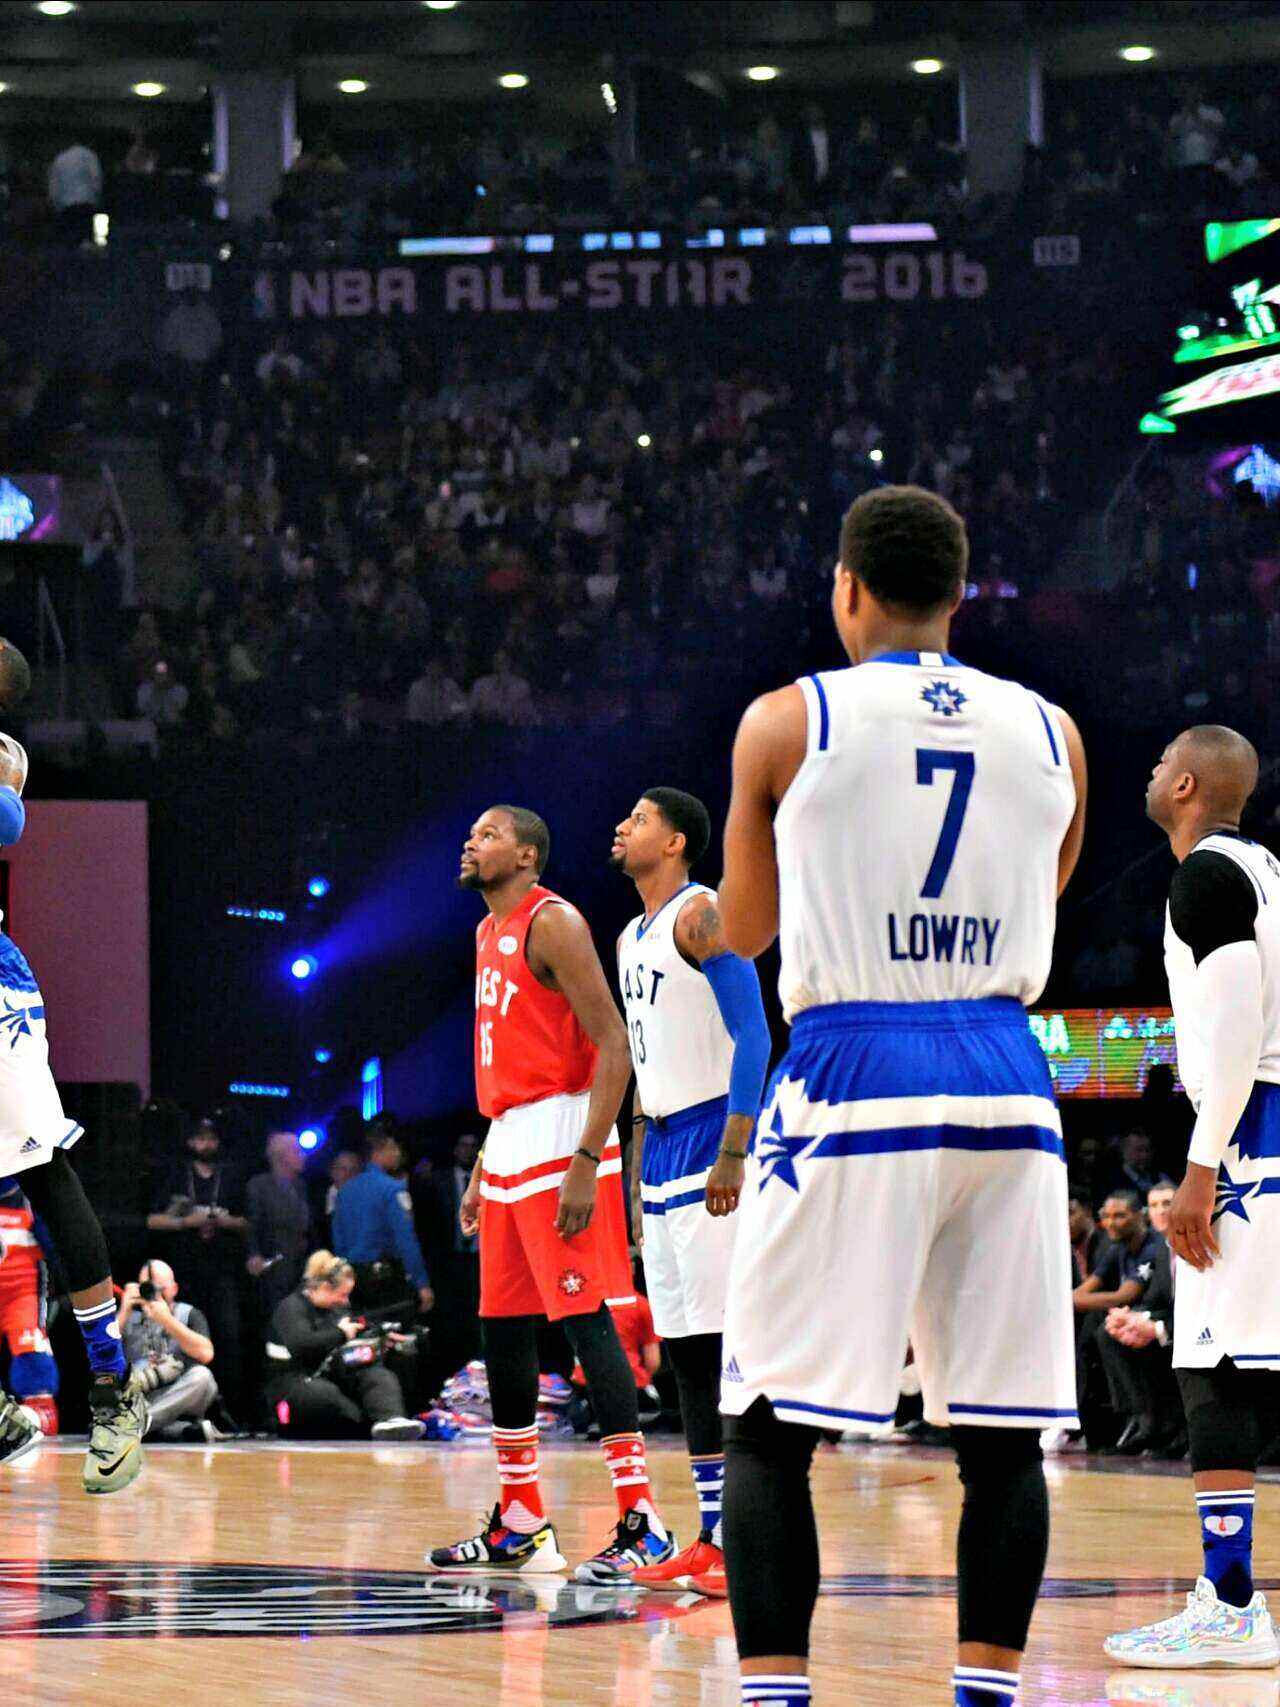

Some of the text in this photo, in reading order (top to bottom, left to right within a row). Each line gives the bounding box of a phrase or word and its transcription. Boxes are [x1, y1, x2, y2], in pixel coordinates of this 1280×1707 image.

[290, 267, 417, 318] NBA
[841, 251, 989, 299] 2016
[916, 748, 975, 899] 7
[888, 913, 1001, 966] LOWRY
[476, 966, 519, 1017] EST
[624, 963, 666, 1006] AST
[631, 1019, 647, 1066] 13
